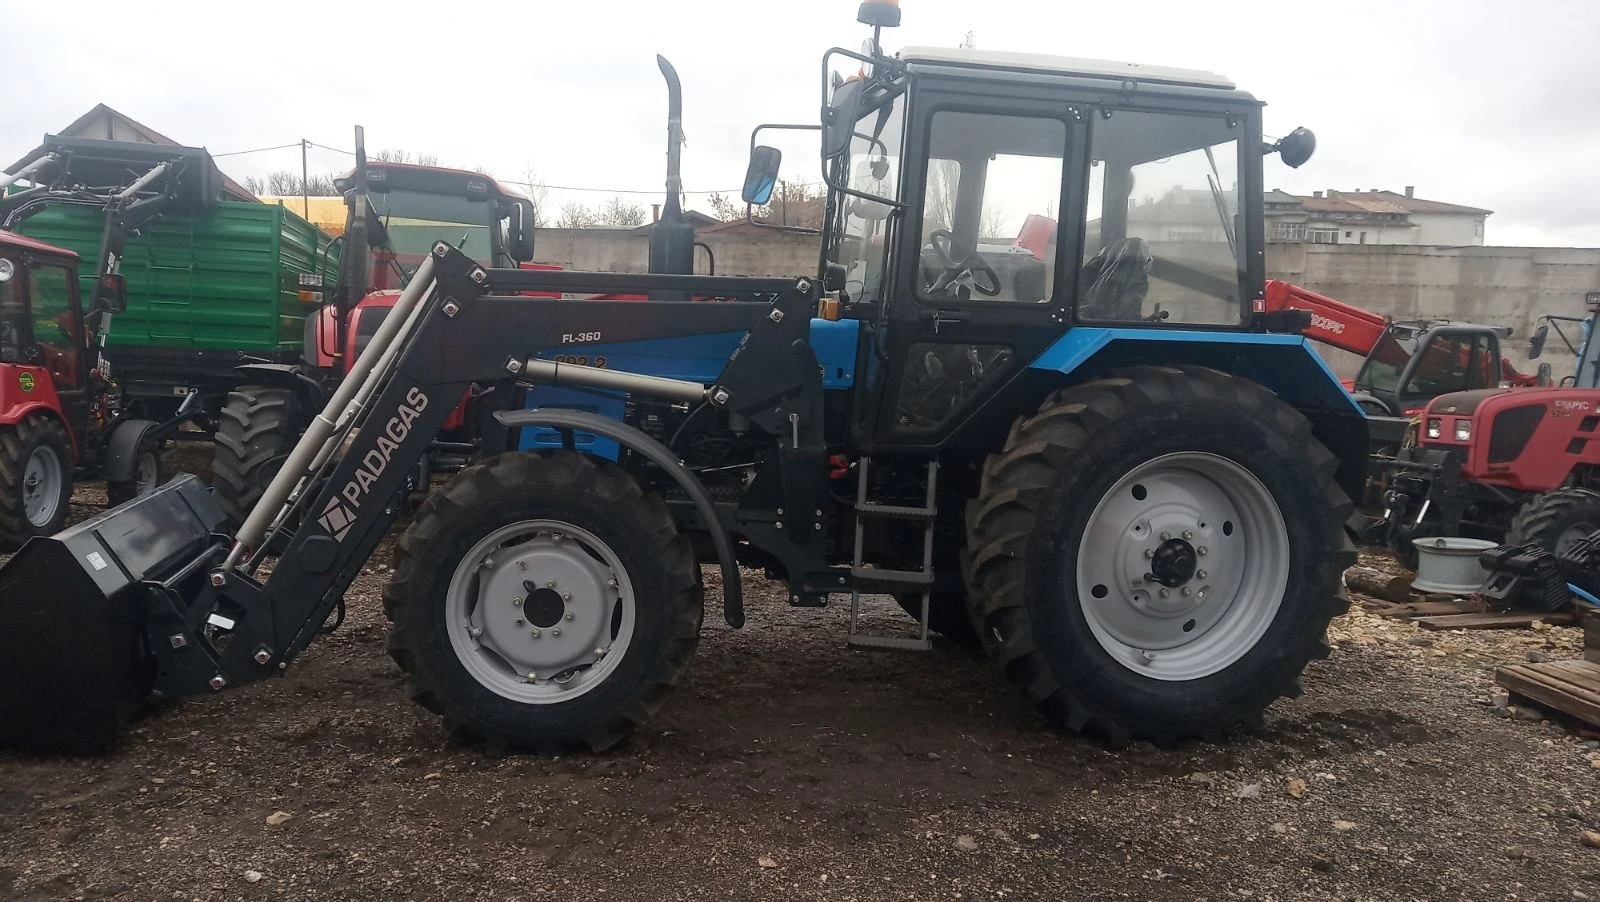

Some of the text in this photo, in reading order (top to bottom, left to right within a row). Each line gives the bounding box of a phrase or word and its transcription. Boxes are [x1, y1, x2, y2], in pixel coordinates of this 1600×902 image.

[562, 331, 601, 344] FL-360
[554, 355, 607, 369] 922
[342, 386, 429, 508] PADAGAS
